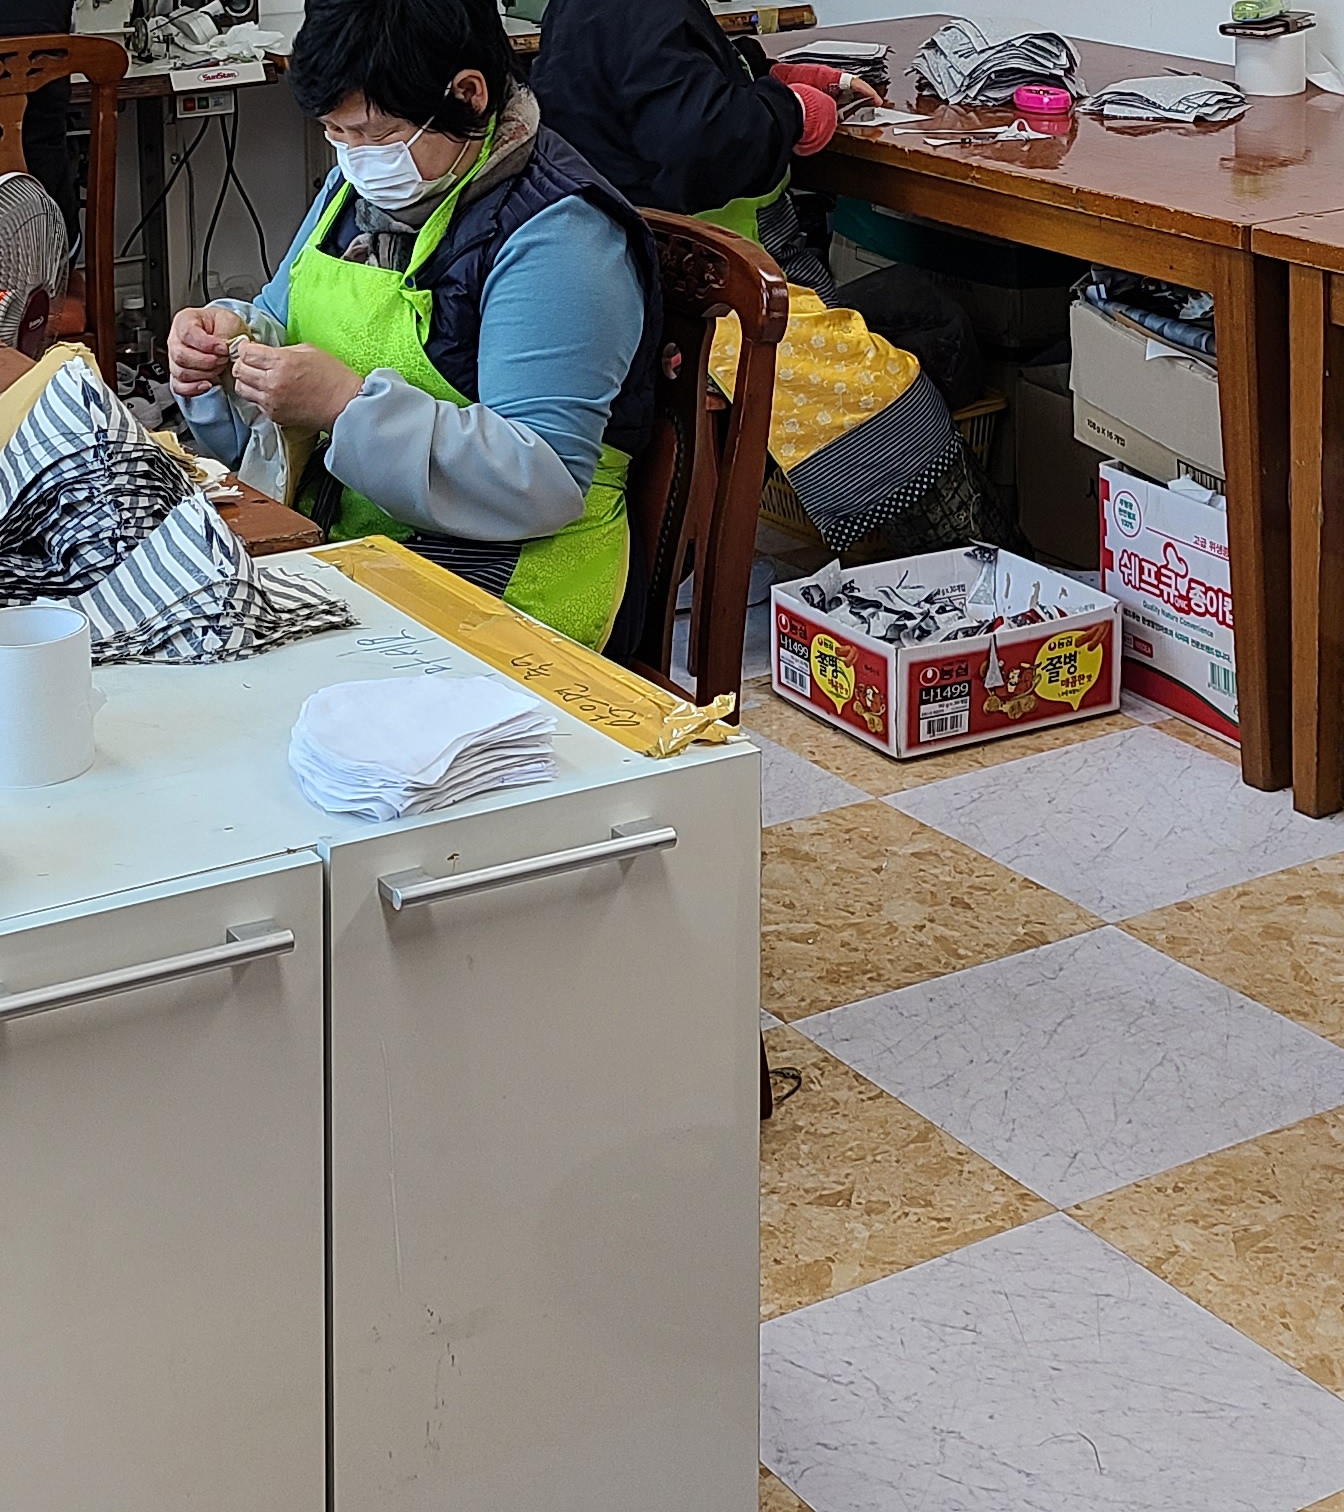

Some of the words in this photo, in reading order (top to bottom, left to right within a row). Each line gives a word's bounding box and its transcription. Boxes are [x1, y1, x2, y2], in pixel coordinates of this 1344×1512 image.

[1119, 549, 1181, 605] 쉐프큐
[779, 633, 809, 659] 나1499
[1041, 650, 1078, 684] 쫄병
[922, 682, 969, 703] 나1499
